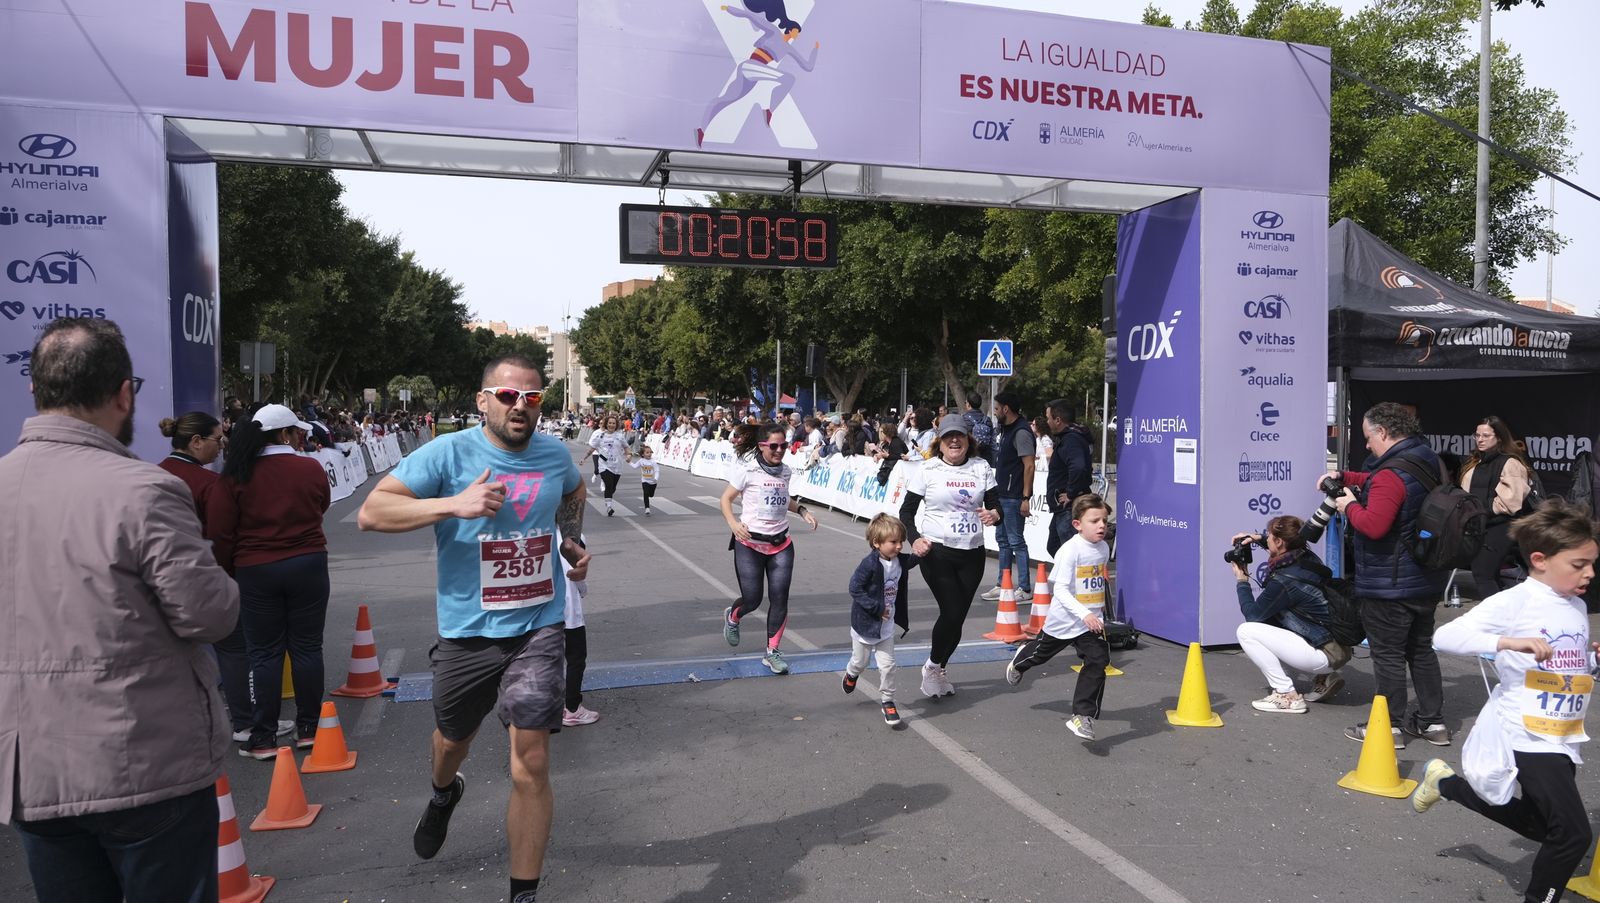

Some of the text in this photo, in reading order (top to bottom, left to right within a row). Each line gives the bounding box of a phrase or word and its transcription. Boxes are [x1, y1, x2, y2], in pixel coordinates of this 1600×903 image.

[185, 1, 535, 104] MUJER
[1002, 37, 1166, 78] LA IGUALDAD
[959, 73, 1204, 120] ES NUESTRA META.
[972, 119, 1014, 142] CDX
[1059, 125, 1106, 140] ALMERÍA
[1059, 137, 1084, 146] CIUDAD
[0, 162, 100, 178] HYUNDAI
[11, 177, 89, 192] Almerialva
[24, 209, 107, 228] cajamar
[658, 210, 827, 262] 00:20:58
[1240, 230, 1295, 243] HYUNDAI
[1247, 241, 1289, 253] Almerialva
[6, 258, 79, 285] CASI
[1254, 264, 1298, 278] cajamar
[32, 303, 106, 320] vithas
[1243, 300, 1282, 319] CASI
[182, 292, 215, 346] CDX
[1127, 319, 1178, 362] CDX
[1256, 331, 1295, 345] vithas
[1247, 372, 1294, 389] aqualia
[1139, 415, 1188, 433] ALMERÍA
[1139, 434, 1163, 444] CIUDAD
[1250, 430, 1280, 442] Clece
[1266, 461, 1292, 481] CASH
[763, 496, 788, 506] 1209
[1248, 493, 1282, 515] ego
[950, 522, 978, 534] 1210
[492, 555, 545, 579] 2587
[1536, 691, 1585, 713] 1716
